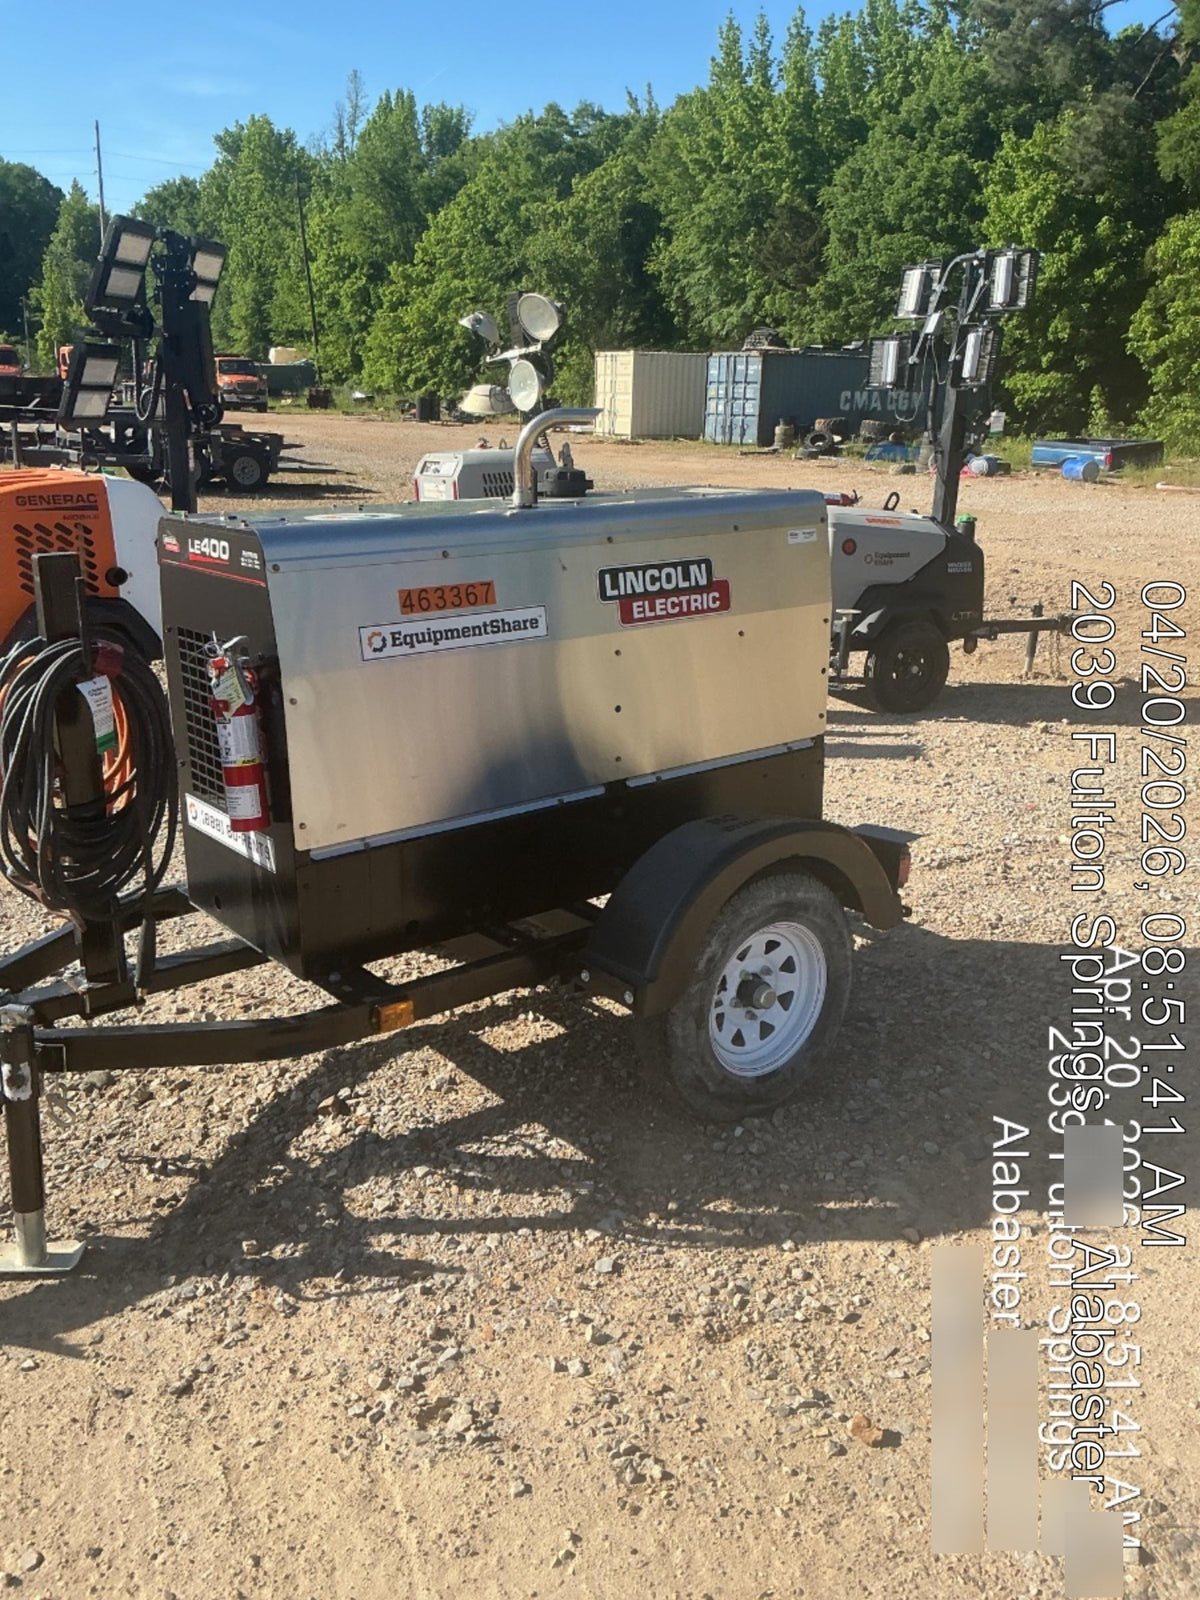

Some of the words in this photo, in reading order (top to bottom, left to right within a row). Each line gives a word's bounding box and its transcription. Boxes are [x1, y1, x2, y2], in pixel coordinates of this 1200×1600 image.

[840, 390, 882, 411] CMA
[15, 493, 98, 507] GENERAC
[188, 537, 230, 561] LE400
[604, 563, 708, 597] LINCOLN
[401, 582, 492, 613] 463367
[632, 591, 720, 619] ELECTRIC
[390, 616, 540, 649] EquipmentShare
